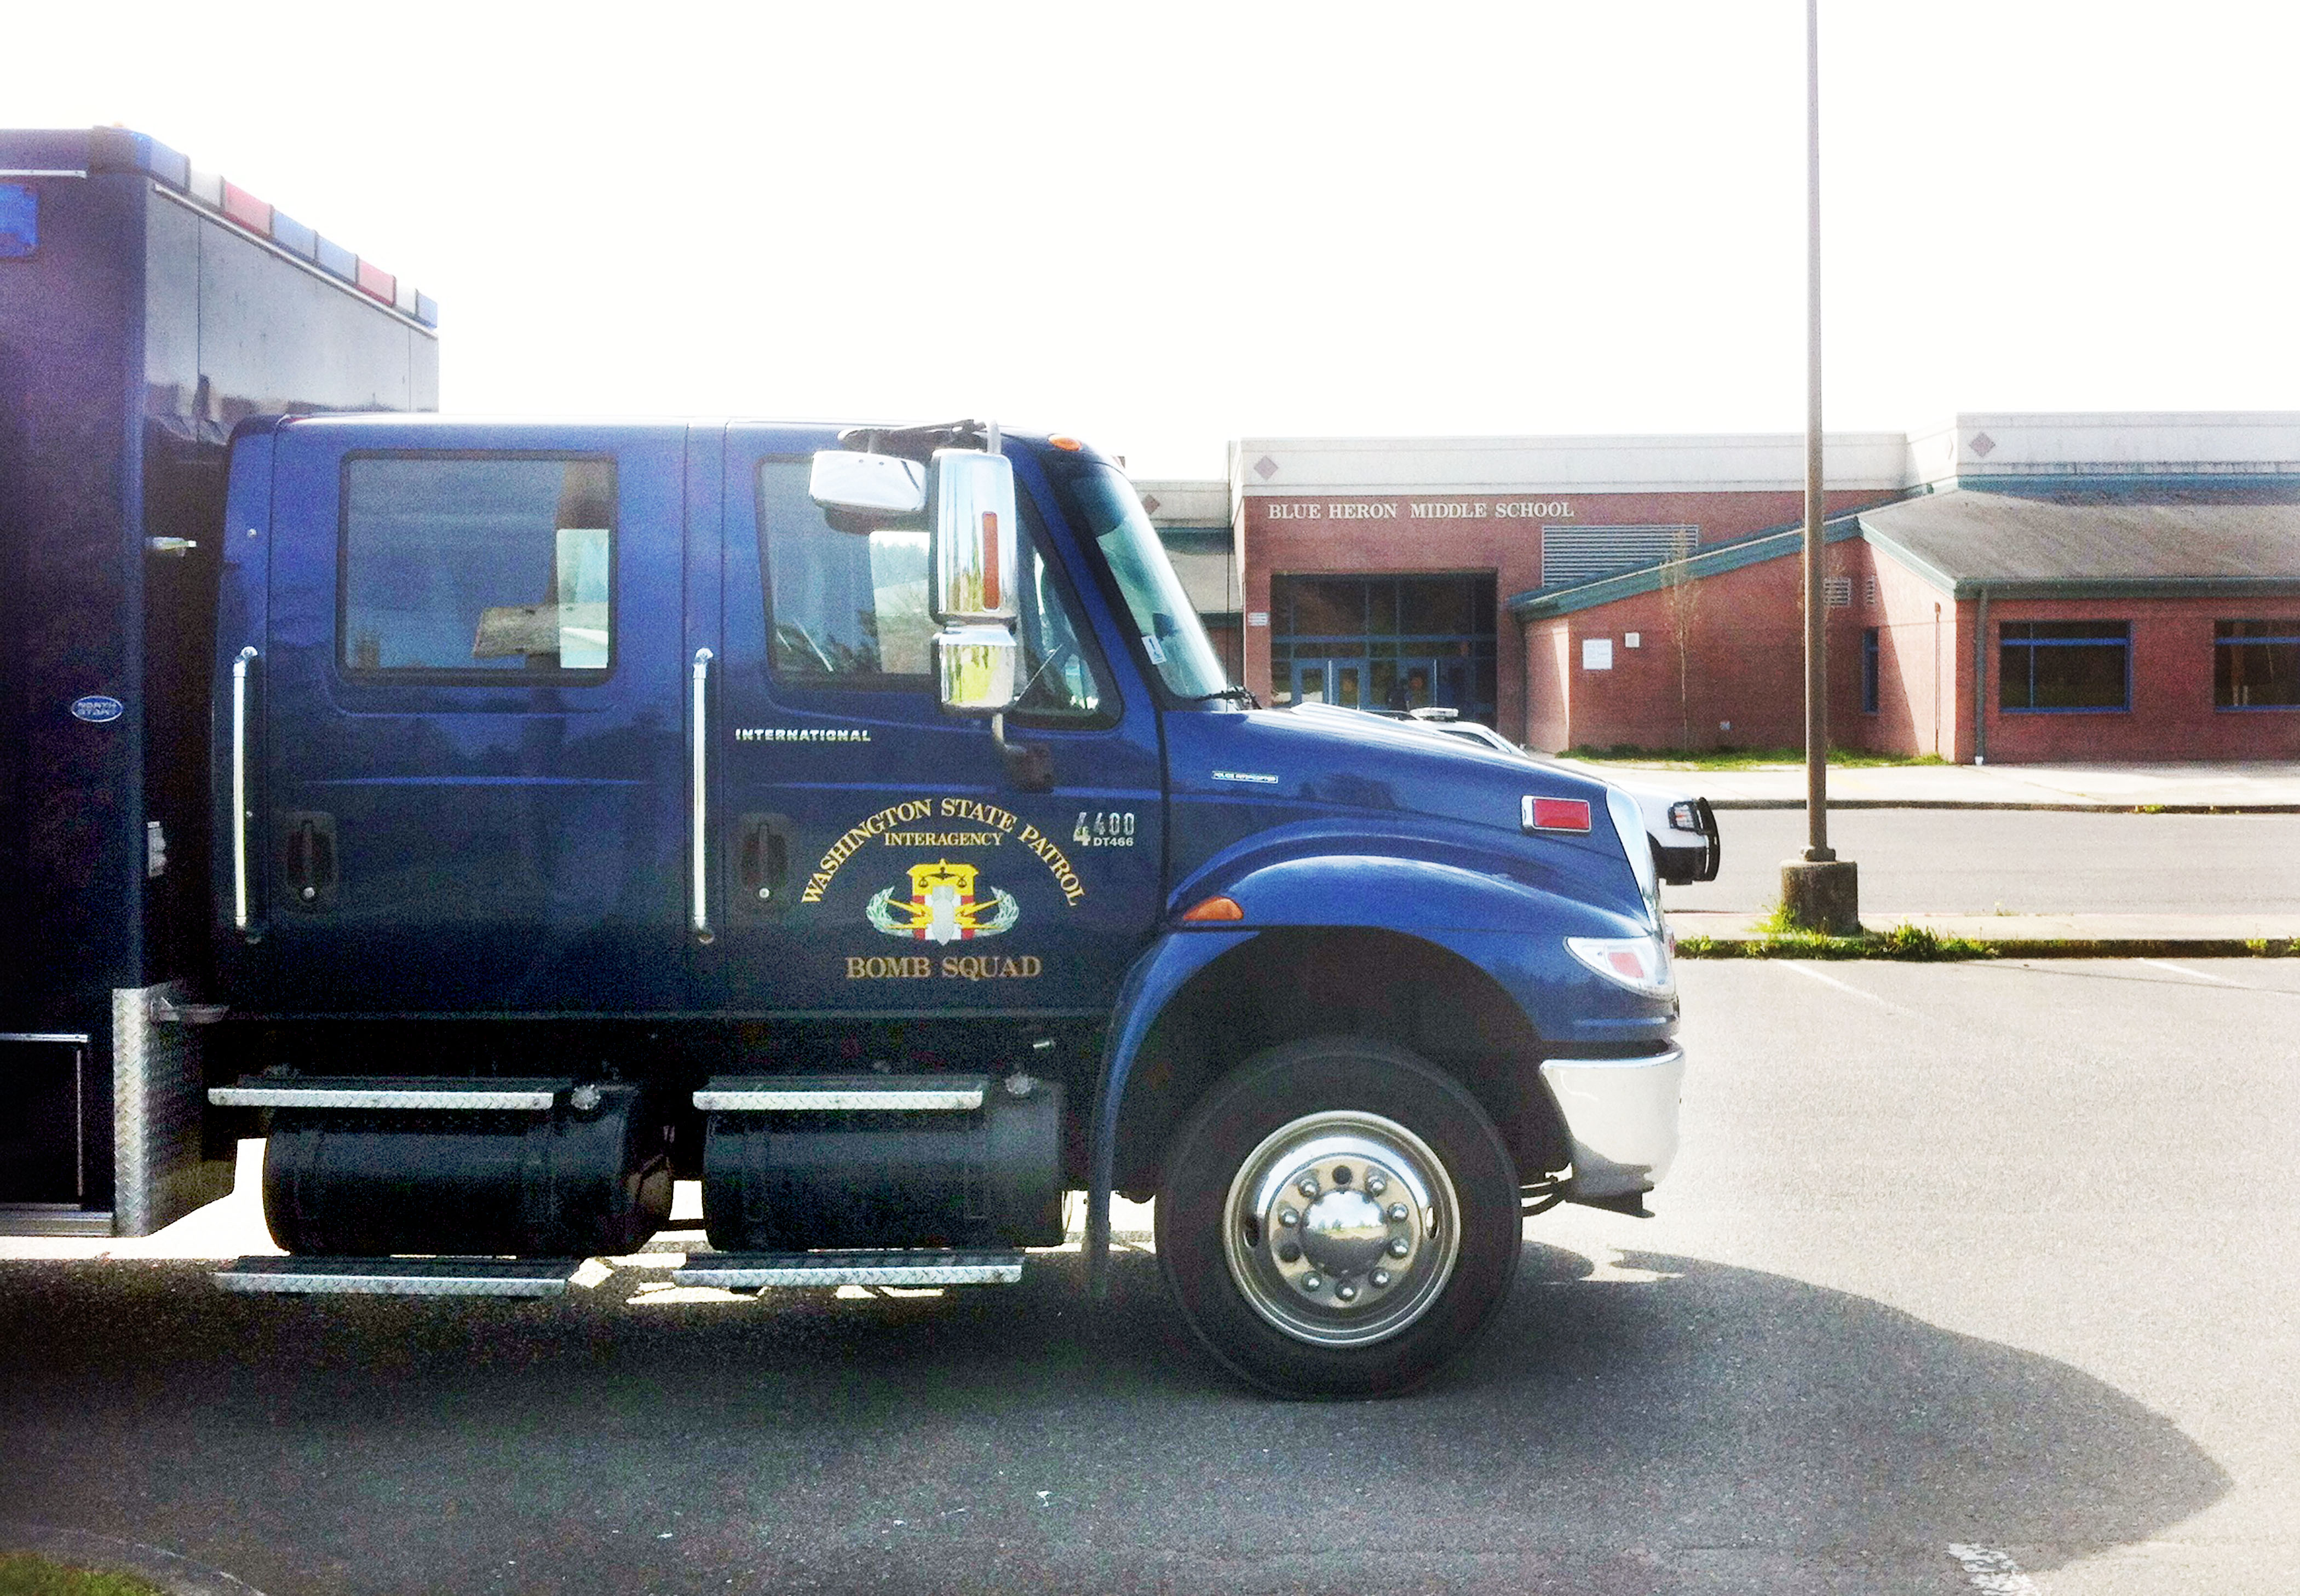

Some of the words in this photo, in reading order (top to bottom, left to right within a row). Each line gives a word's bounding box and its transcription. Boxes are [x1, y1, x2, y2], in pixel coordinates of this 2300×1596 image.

[1268, 504, 1321, 518] BLUE
[1328, 503, 1398, 518] HERON
[1410, 503, 1487, 518] MIDDLE
[1495, 502, 1574, 517] SCHOOL
[735, 729, 871, 741] INTERNATIONAL
[1073, 812, 1135, 846] 4400
[884, 832, 1004, 846] INTERAGENCY
[1093, 837, 1134, 846] DT466
[801, 799, 932, 902] WASHINGTON
[941, 798, 1017, 833] STATE
[1017, 823, 1085, 906] PATROL
[846, 957, 932, 978] BOMB
[941, 957, 1042, 981] SQUAD
